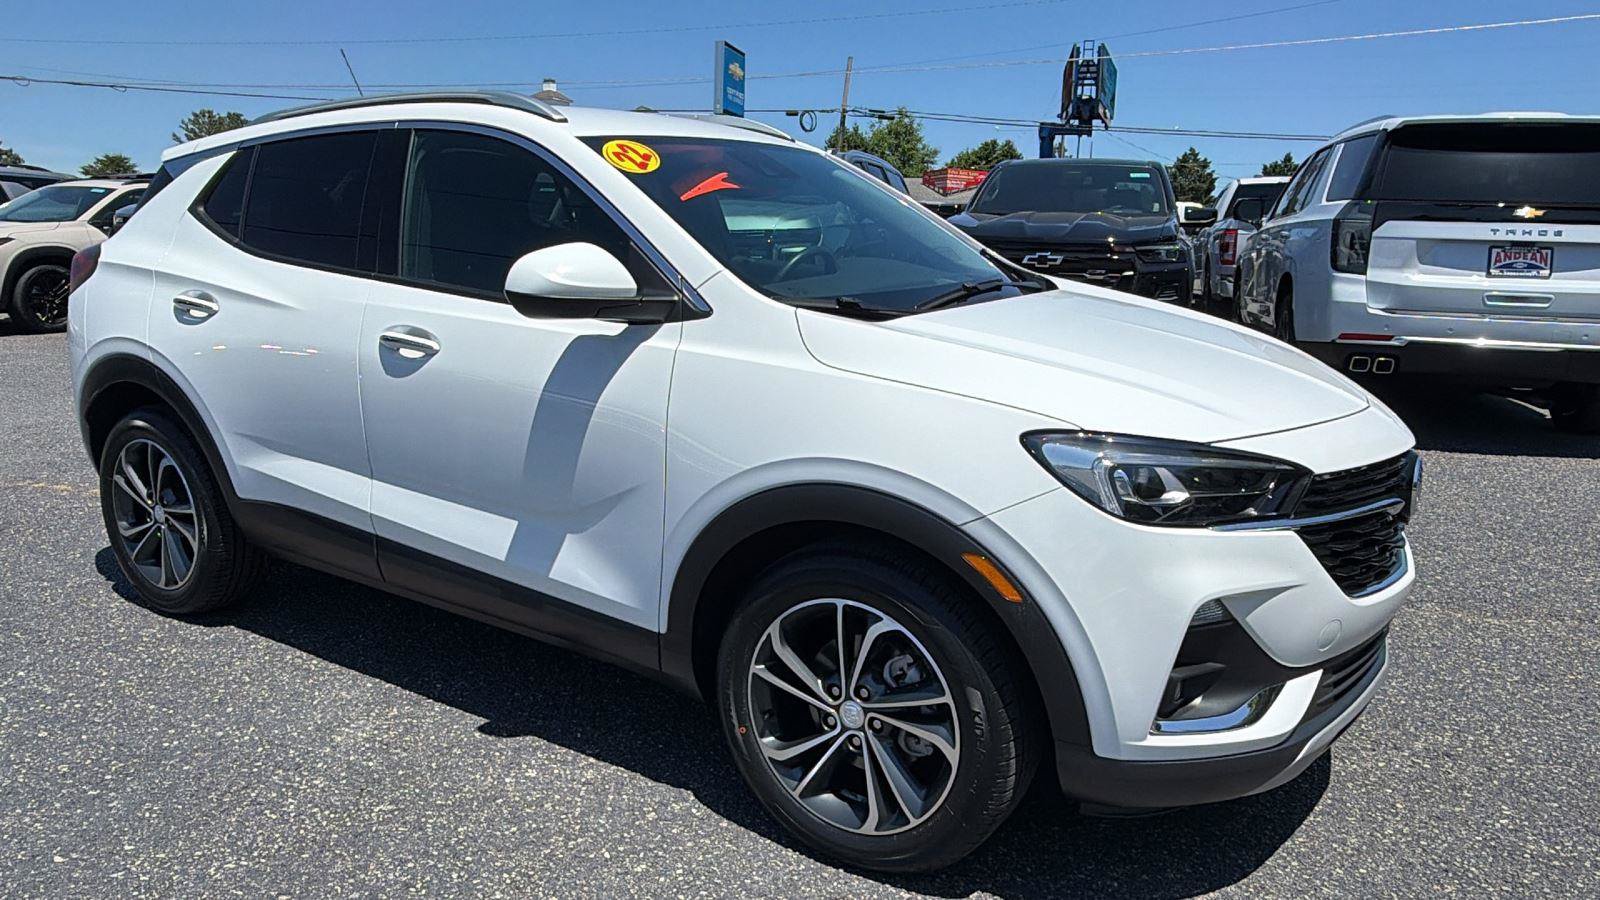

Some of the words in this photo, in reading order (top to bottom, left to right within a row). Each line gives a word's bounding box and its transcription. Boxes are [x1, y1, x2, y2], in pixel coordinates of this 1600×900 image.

[612, 143, 652, 170] 22
[1490, 228, 1564, 237] TAHOE
[1494, 251, 1548, 267] ANDEAN
